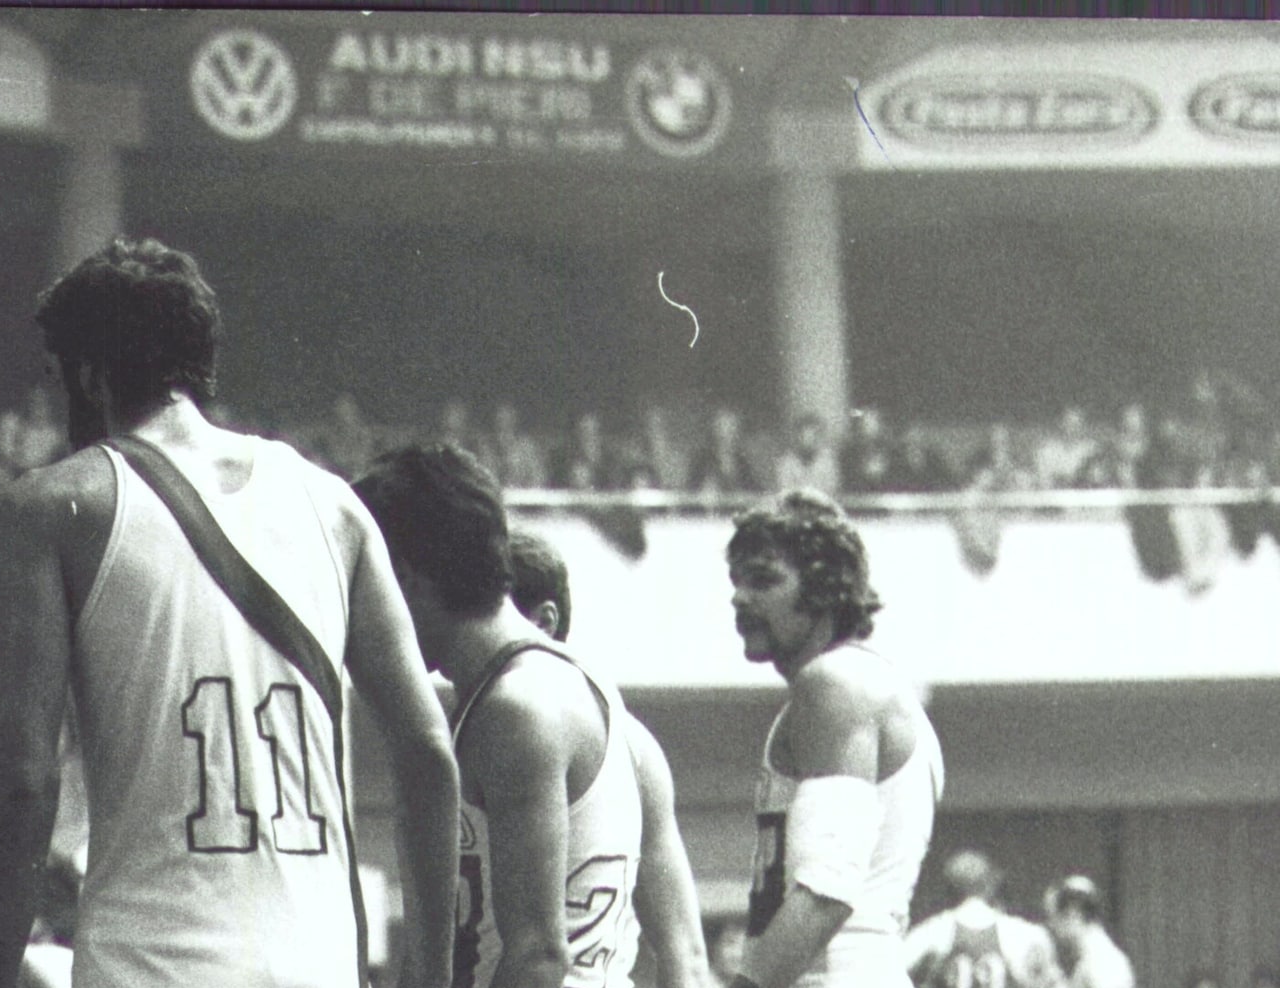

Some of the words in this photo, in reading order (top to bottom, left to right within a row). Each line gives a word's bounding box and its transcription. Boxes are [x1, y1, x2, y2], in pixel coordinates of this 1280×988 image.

[330, 32, 473, 76] AUDI
[482, 37, 611, 82] NSU
[180, 675, 328, 855] 11
